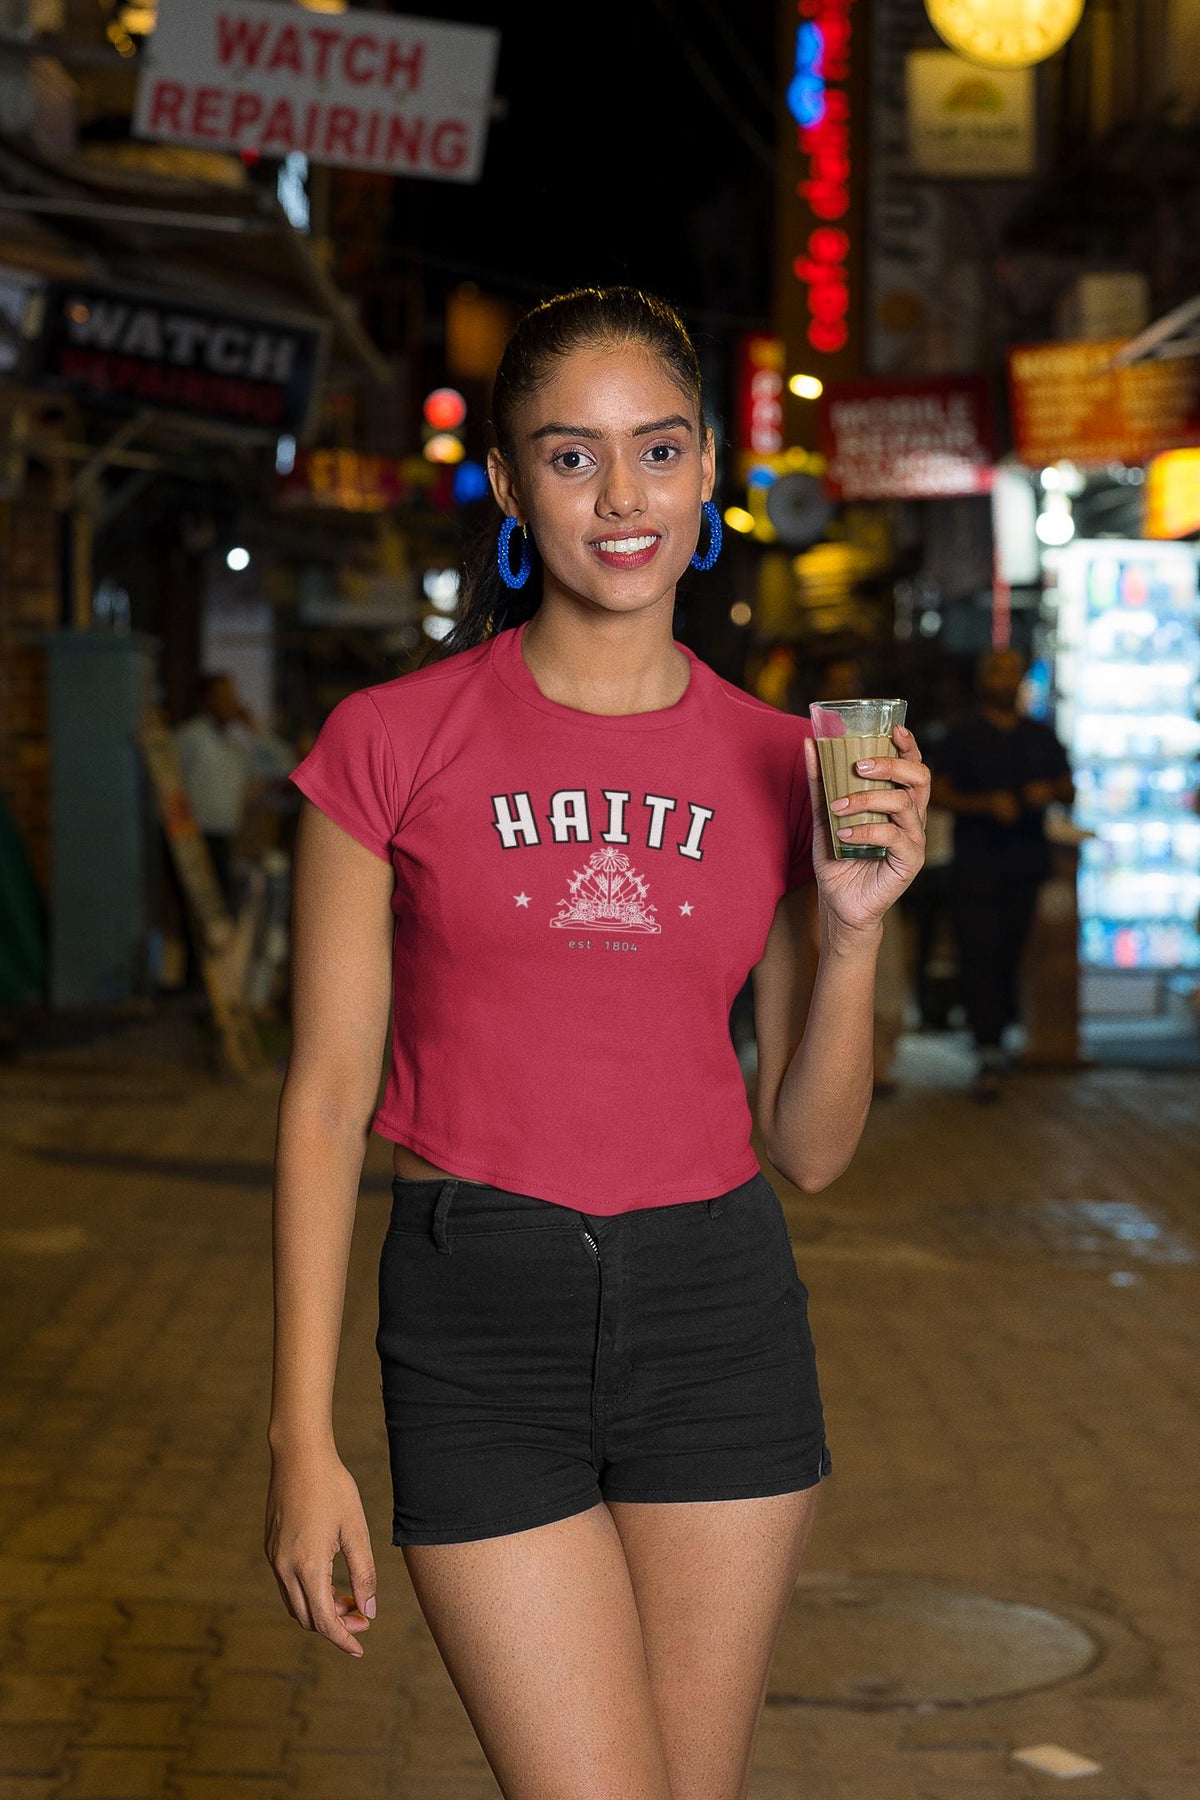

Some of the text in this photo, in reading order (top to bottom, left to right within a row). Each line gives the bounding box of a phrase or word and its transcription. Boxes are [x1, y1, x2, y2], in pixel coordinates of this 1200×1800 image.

[215, 13, 428, 91] WATCH
[149, 80, 469, 173] REPAIRING
[67, 297, 296, 384] WATCH
[491, 789, 715, 861] HAITI
[604, 940, 639, 952] 1804
